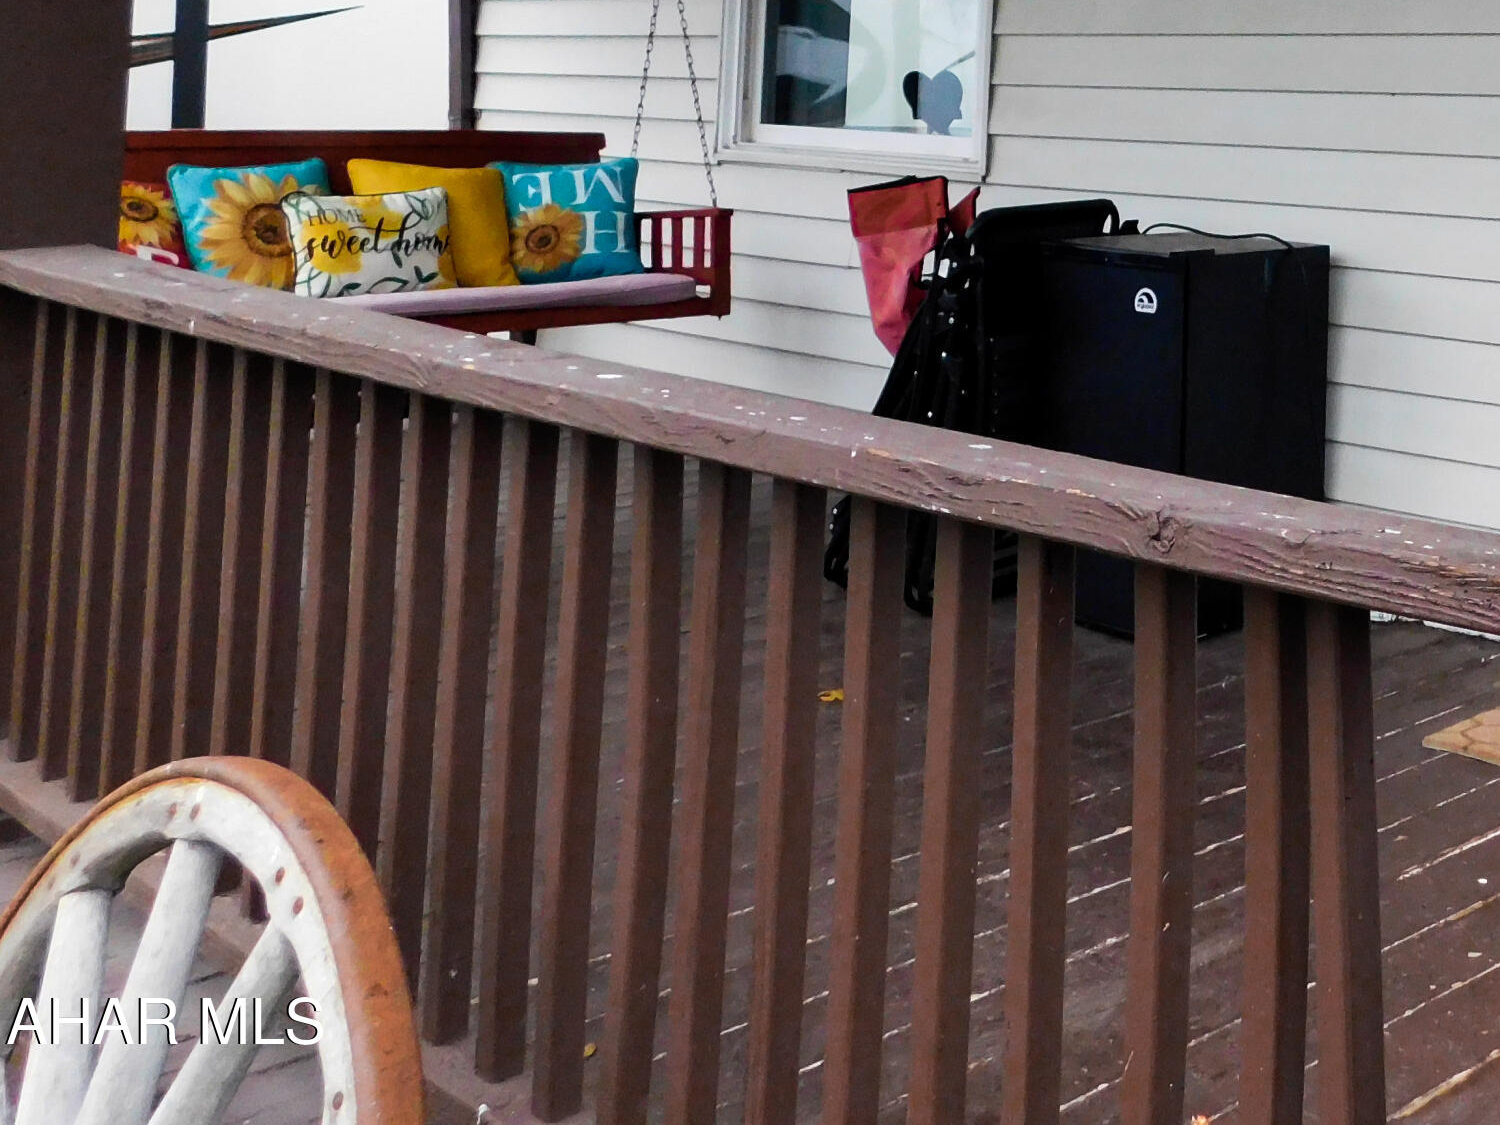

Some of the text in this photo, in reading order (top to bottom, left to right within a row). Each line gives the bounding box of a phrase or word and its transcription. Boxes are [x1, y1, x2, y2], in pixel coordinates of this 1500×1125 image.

[307, 208, 367, 227] HOME
[304, 210, 450, 268] sweet hom
